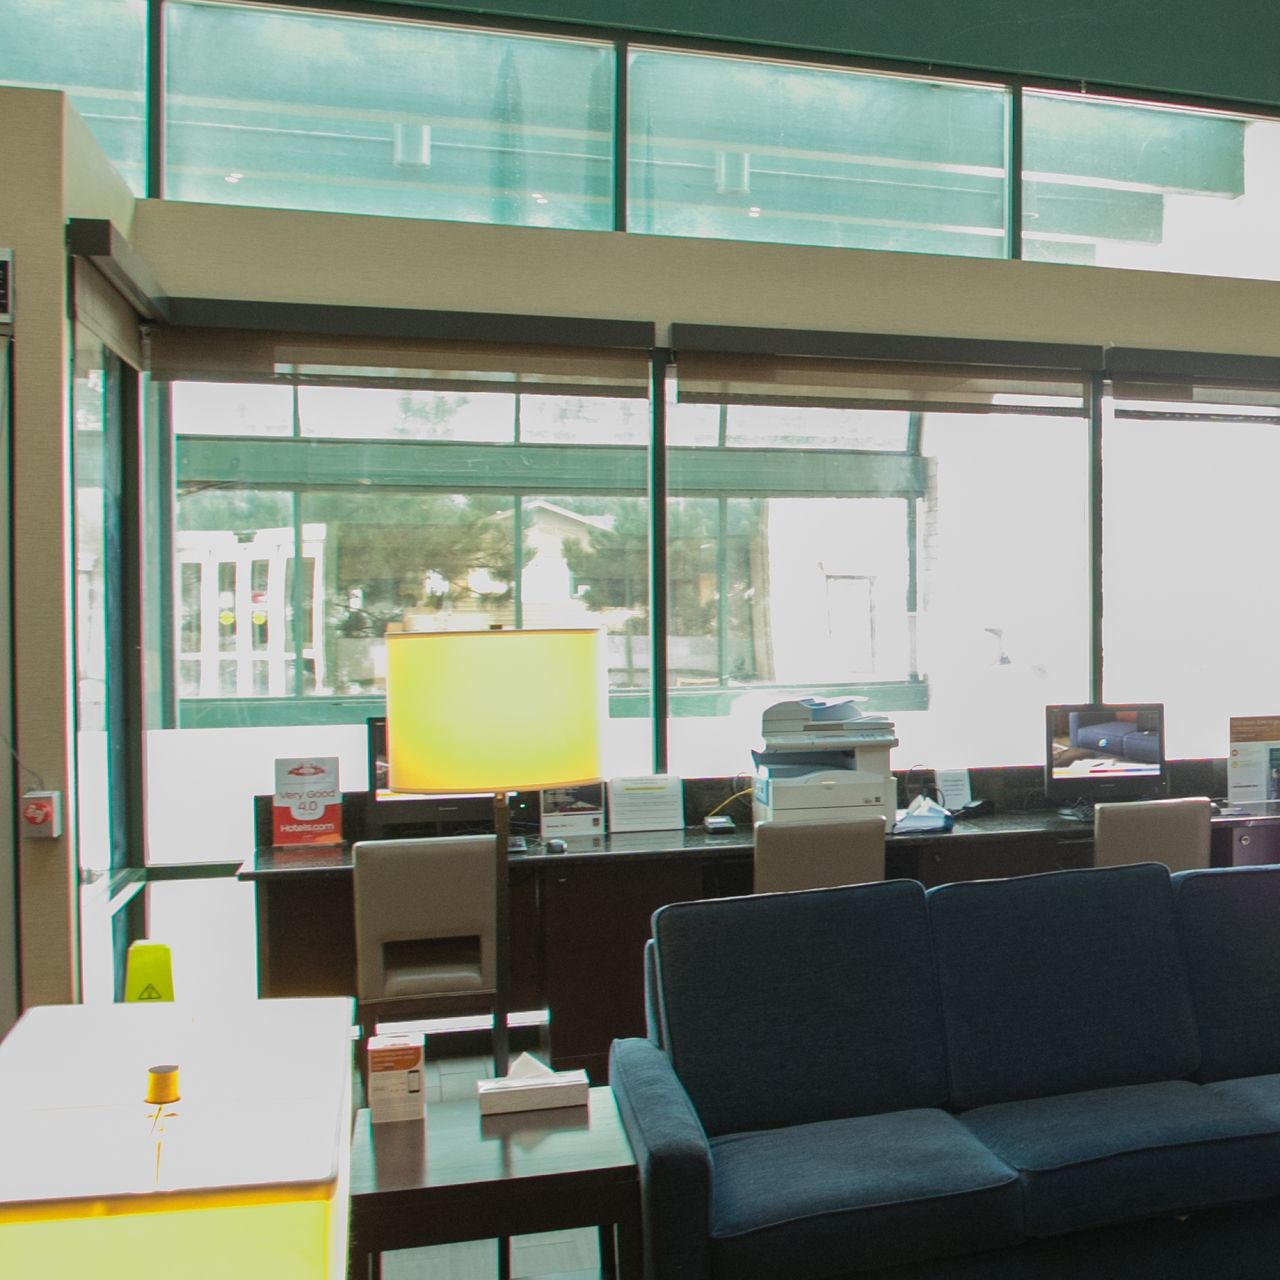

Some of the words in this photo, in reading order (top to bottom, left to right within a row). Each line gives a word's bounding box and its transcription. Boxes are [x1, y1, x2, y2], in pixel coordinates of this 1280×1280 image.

[279, 791, 304, 801] Very
[306, 790, 335, 799] Good
[298, 801, 318, 811] 4.0
[280, 823, 335, 833] Hotels.com
